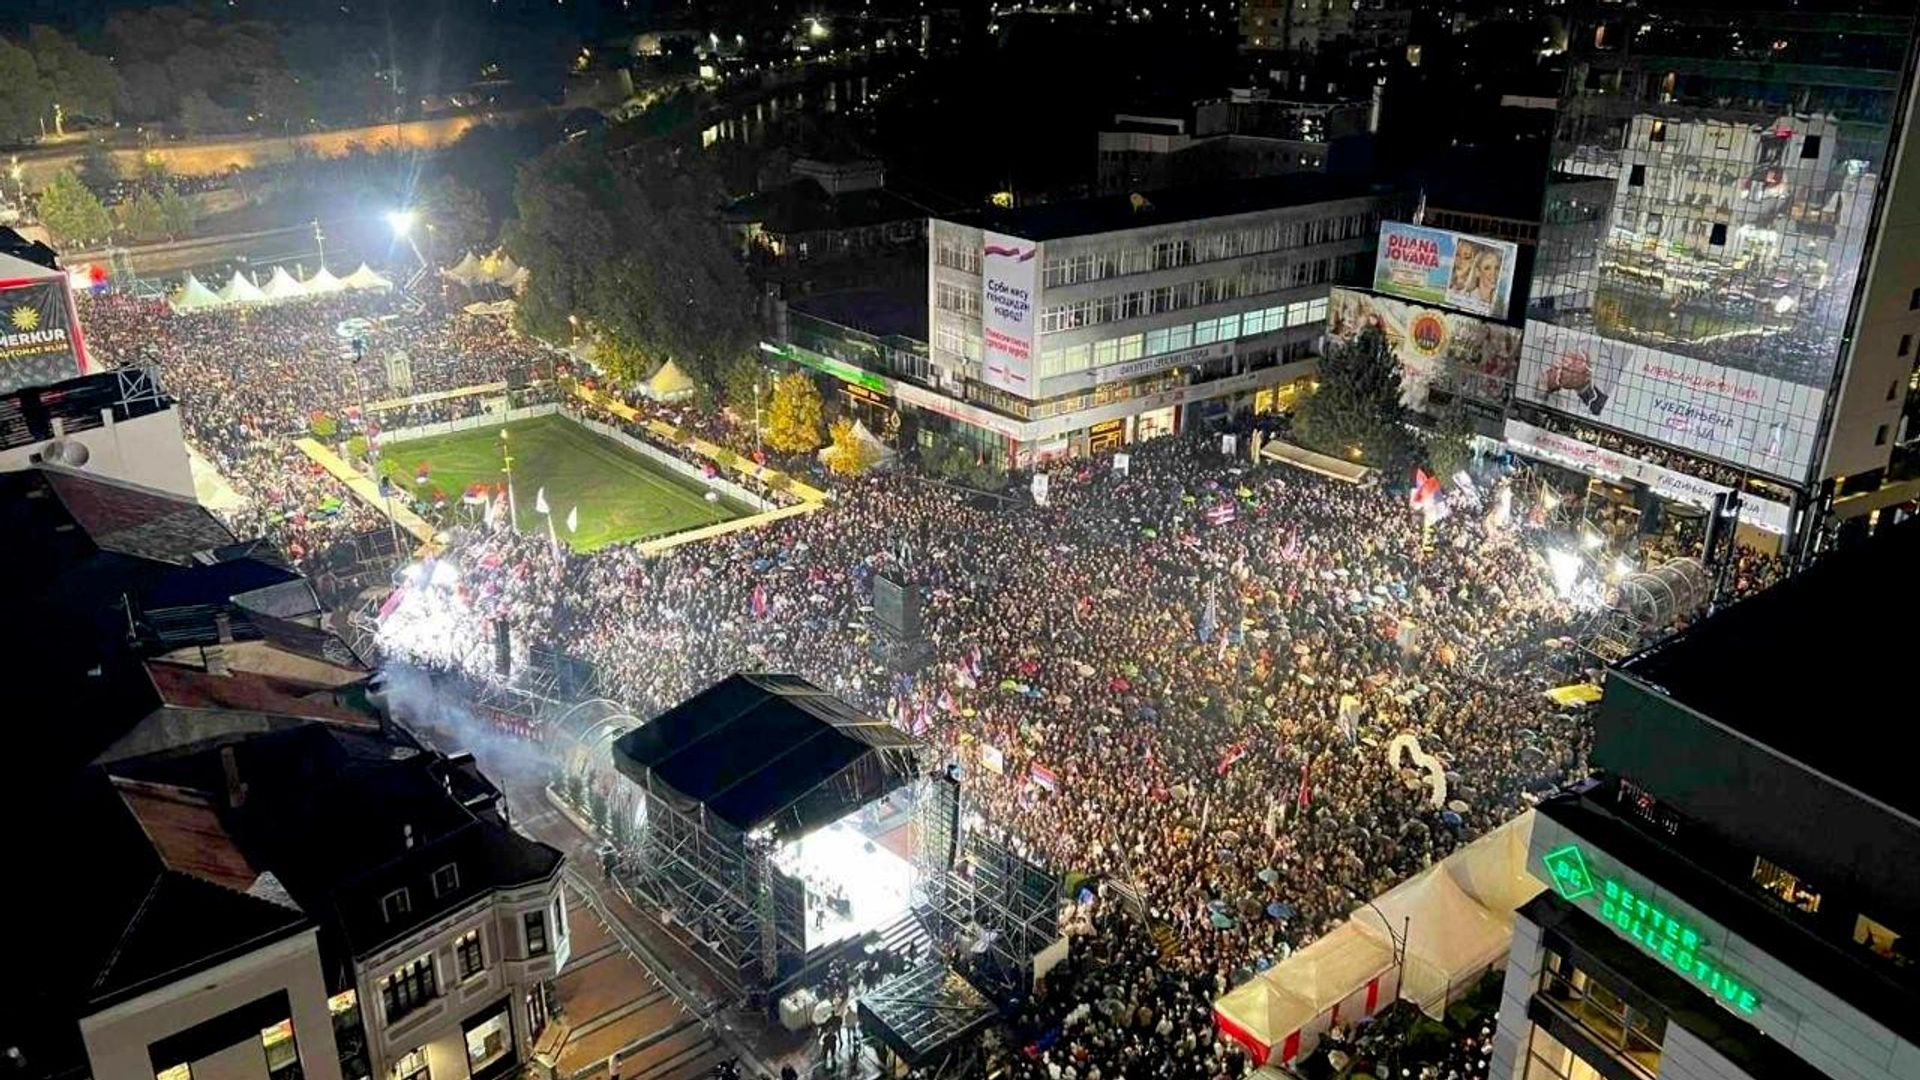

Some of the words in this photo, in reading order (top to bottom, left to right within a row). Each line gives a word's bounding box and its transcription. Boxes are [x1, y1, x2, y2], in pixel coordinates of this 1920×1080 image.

[1384, 249, 1440, 268] JOVANA
[988, 279, 1009, 294] Срби
[994, 306, 1023, 323] народ!
[0, 328, 66, 348] MERKUR
[1653, 398, 1734, 429] УЈЕДИЊЕНА
[1605, 880, 1698, 951] BETTER
[1601, 901, 1757, 1014] COLLECTIVE
